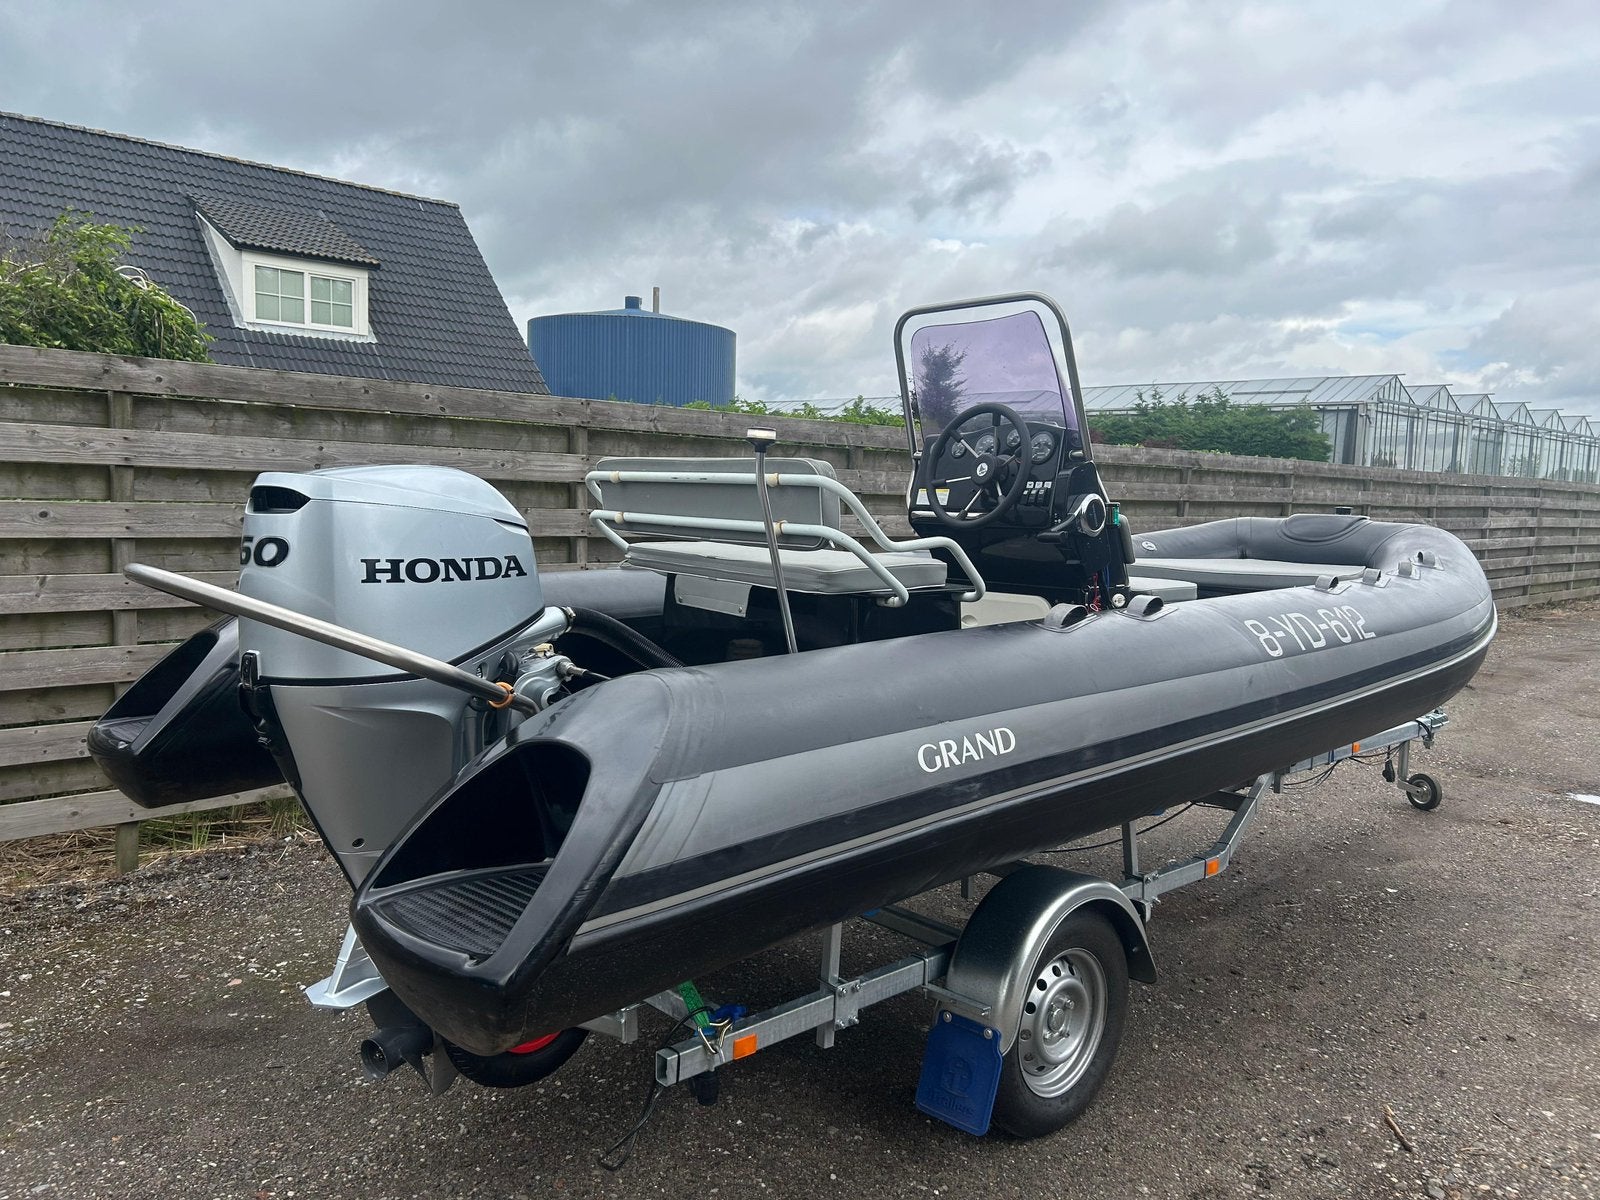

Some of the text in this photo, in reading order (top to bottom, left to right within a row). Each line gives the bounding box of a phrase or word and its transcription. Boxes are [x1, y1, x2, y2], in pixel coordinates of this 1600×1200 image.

[360, 554, 528, 584] HONDA
[1243, 605, 1377, 658] 8-YD-612
[917, 727, 1016, 773] GRAND
